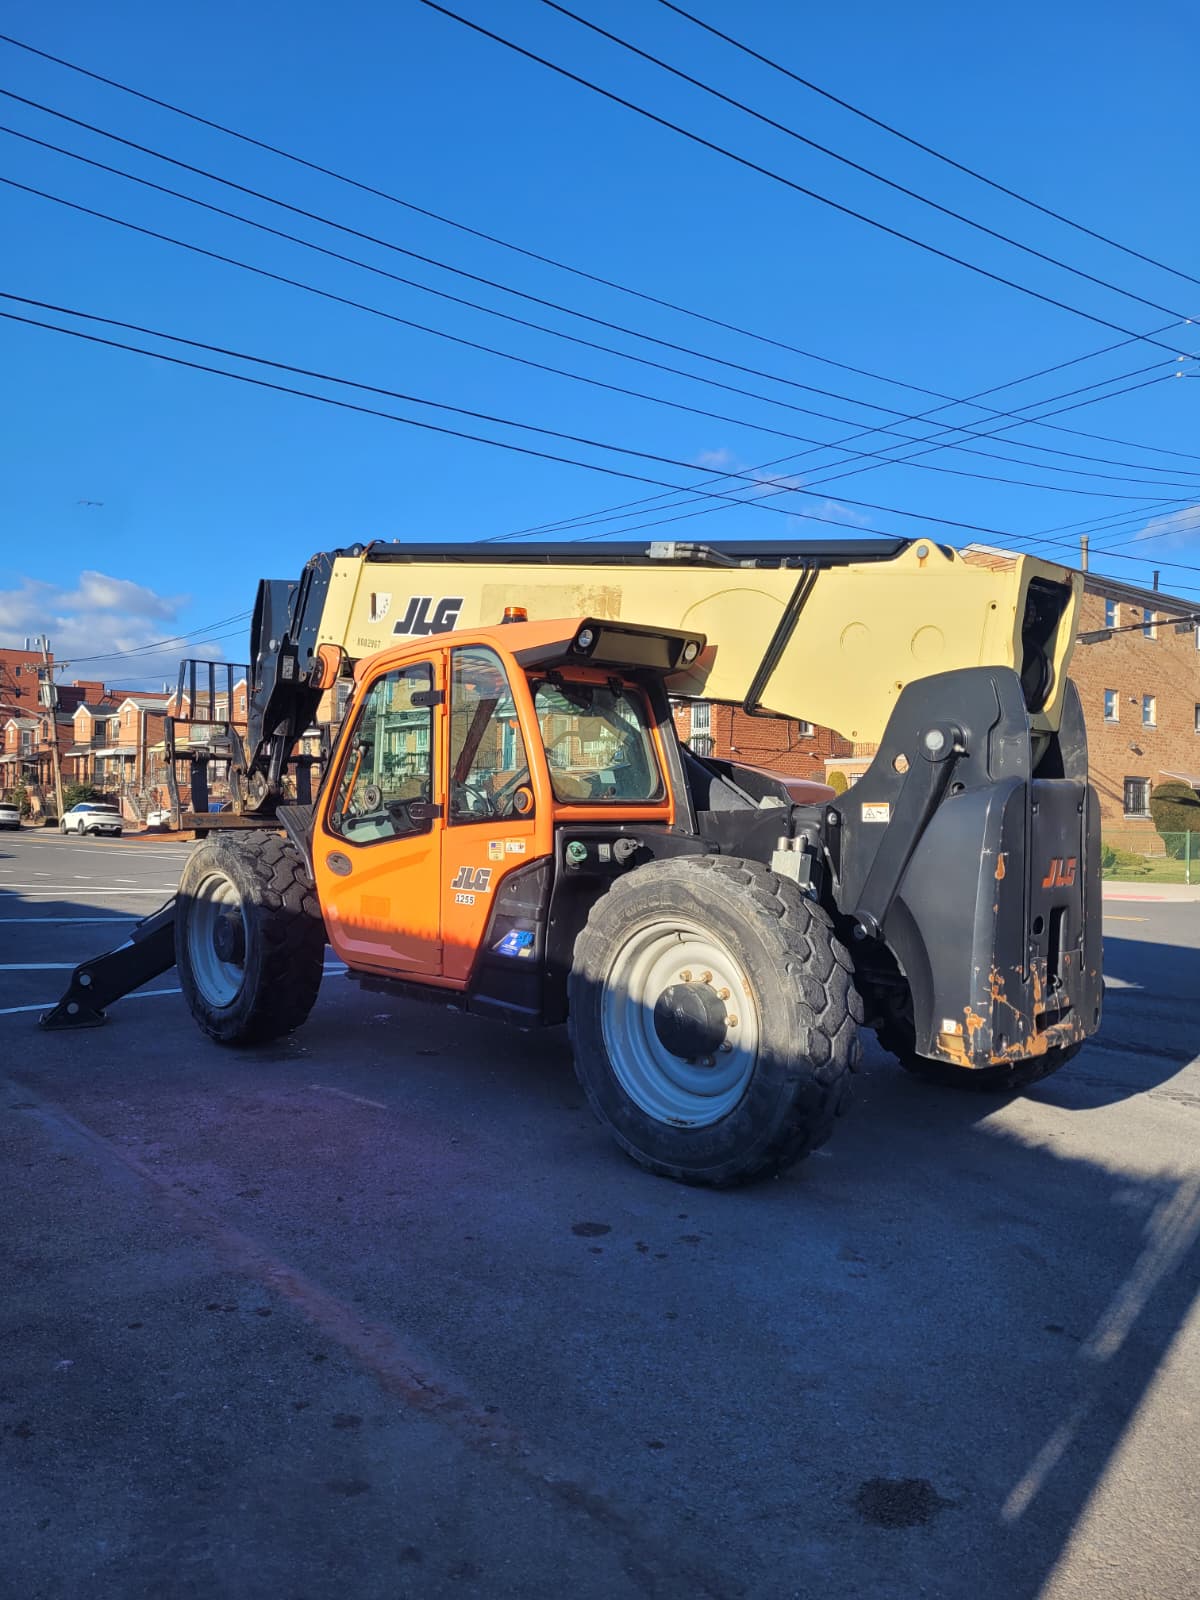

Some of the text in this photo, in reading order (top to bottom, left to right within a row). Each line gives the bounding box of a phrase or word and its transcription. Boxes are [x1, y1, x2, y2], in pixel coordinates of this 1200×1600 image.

[393, 597, 464, 635] JLG
[451, 866, 492, 893] JLG
[1042, 857, 1077, 889] JLG
[456, 894, 475, 905] 1255
